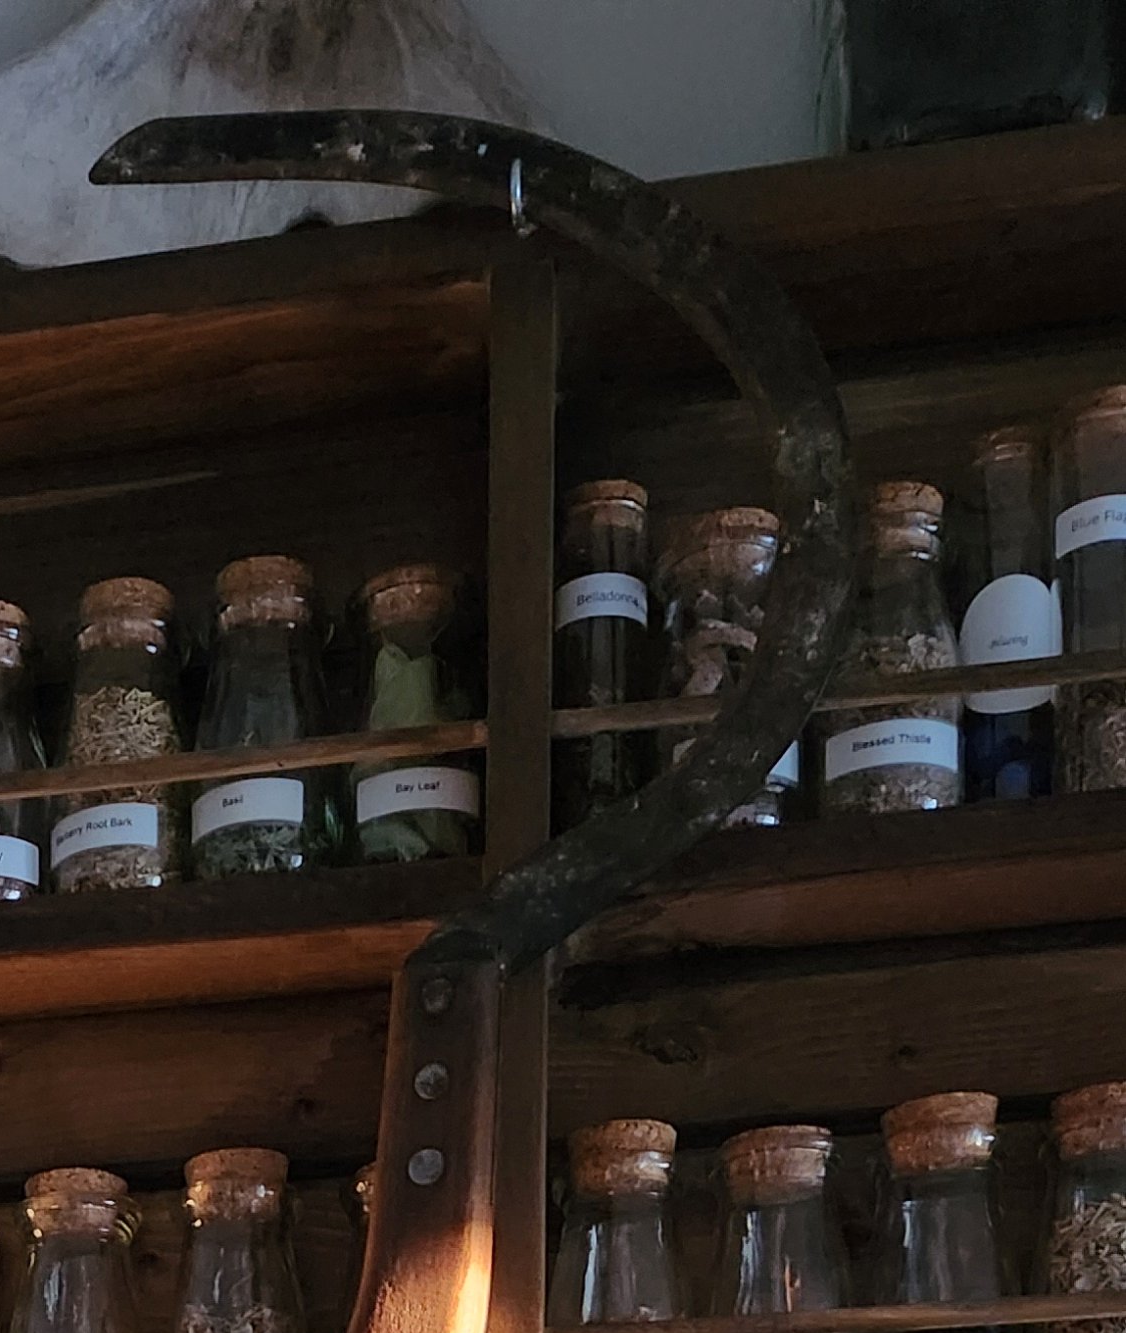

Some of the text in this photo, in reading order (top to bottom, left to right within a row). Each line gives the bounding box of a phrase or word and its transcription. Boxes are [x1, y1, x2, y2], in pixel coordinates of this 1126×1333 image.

[852, 733, 932, 752] Blessed Thistle
[395, 781, 441, 794] Bay Leaf
[222, 796, 244, 807] Basil
[85, 819, 108, 831] Root
[110, 817, 133, 828] Bark
